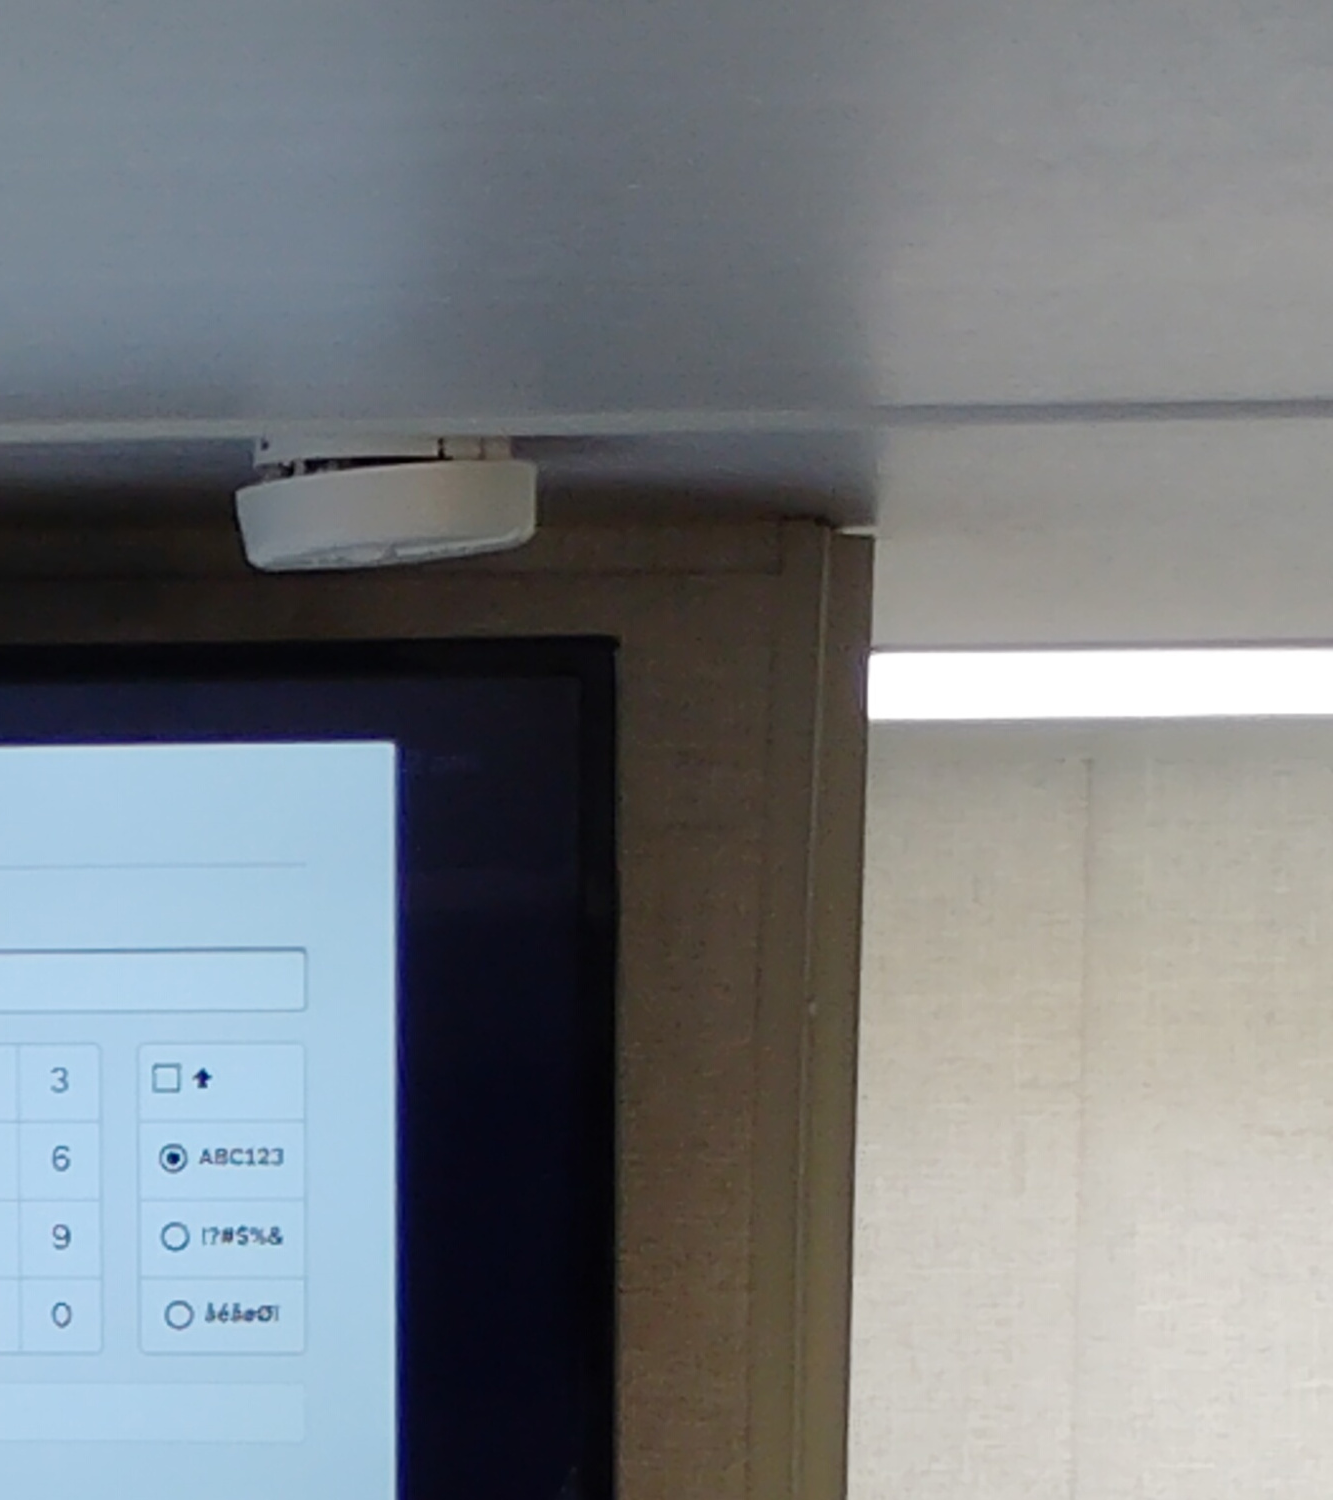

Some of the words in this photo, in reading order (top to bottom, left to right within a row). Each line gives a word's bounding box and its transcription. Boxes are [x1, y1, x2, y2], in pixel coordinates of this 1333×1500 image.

[49, 1065, 71, 1095] 3
[50, 1144, 72, 1174] 6
[197, 1146, 285, 1168] ABC123
[51, 1222, 73, 1252] 9
[50, 1300, 73, 1330] 0
